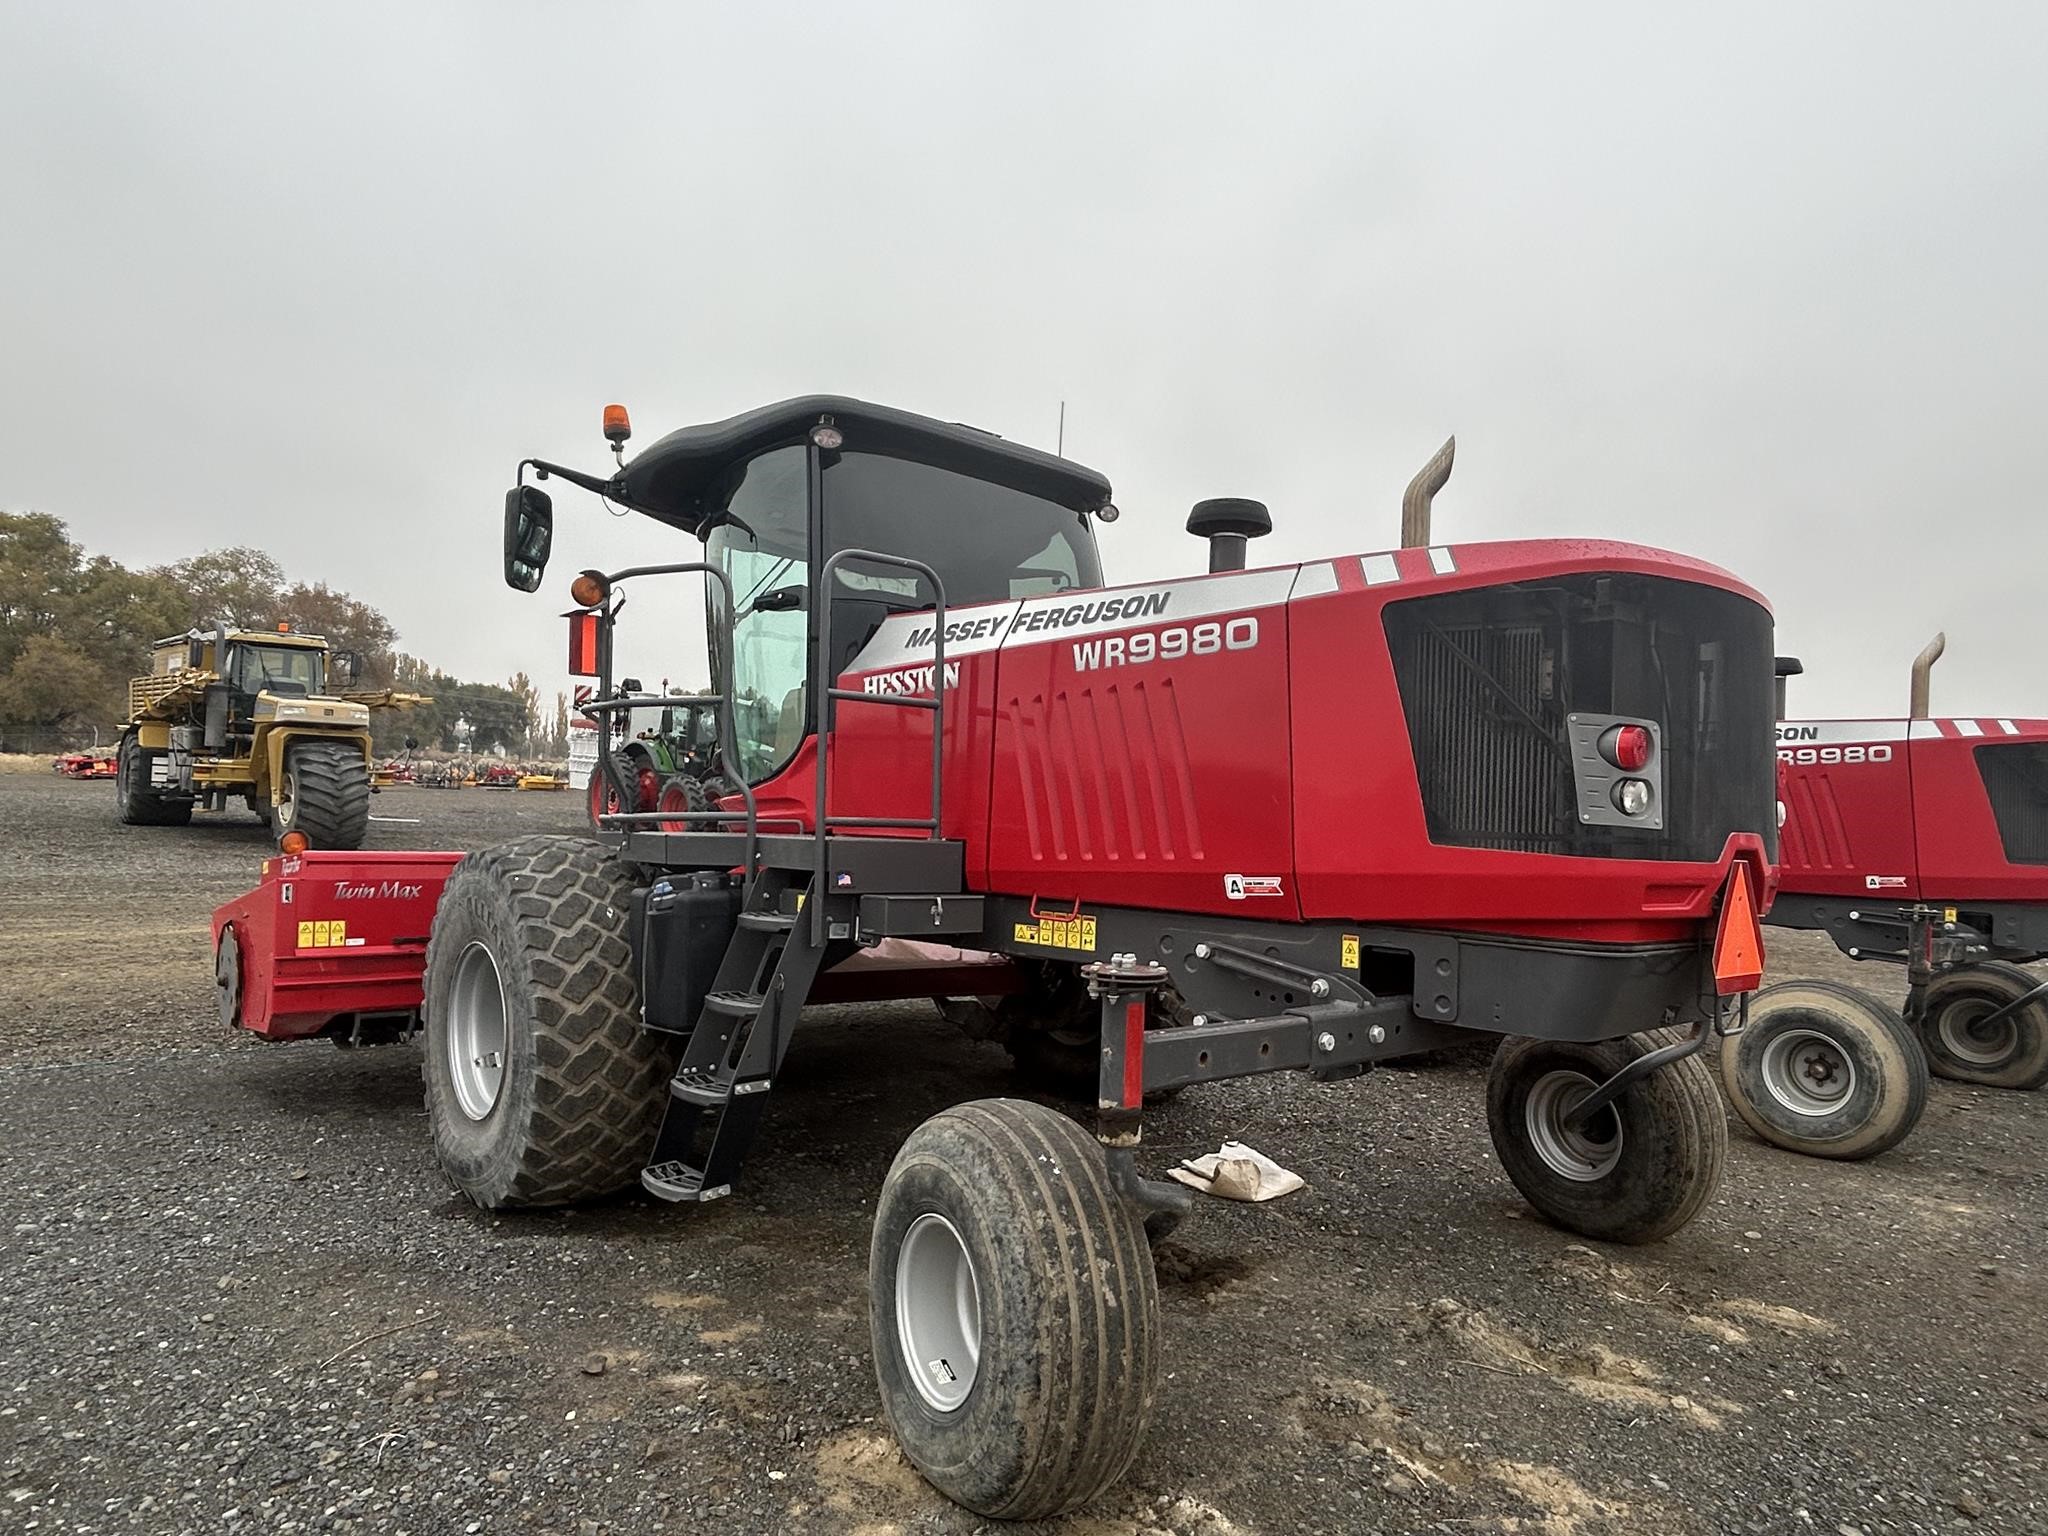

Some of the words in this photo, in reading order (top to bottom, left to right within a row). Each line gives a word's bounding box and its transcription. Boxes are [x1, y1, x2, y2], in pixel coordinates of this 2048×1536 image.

[1011, 591, 1171, 634] FERGUSON
[1072, 617, 1258, 672] WR9980
[334, 881, 376, 900] Twin
[376, 881, 423, 900] Max
